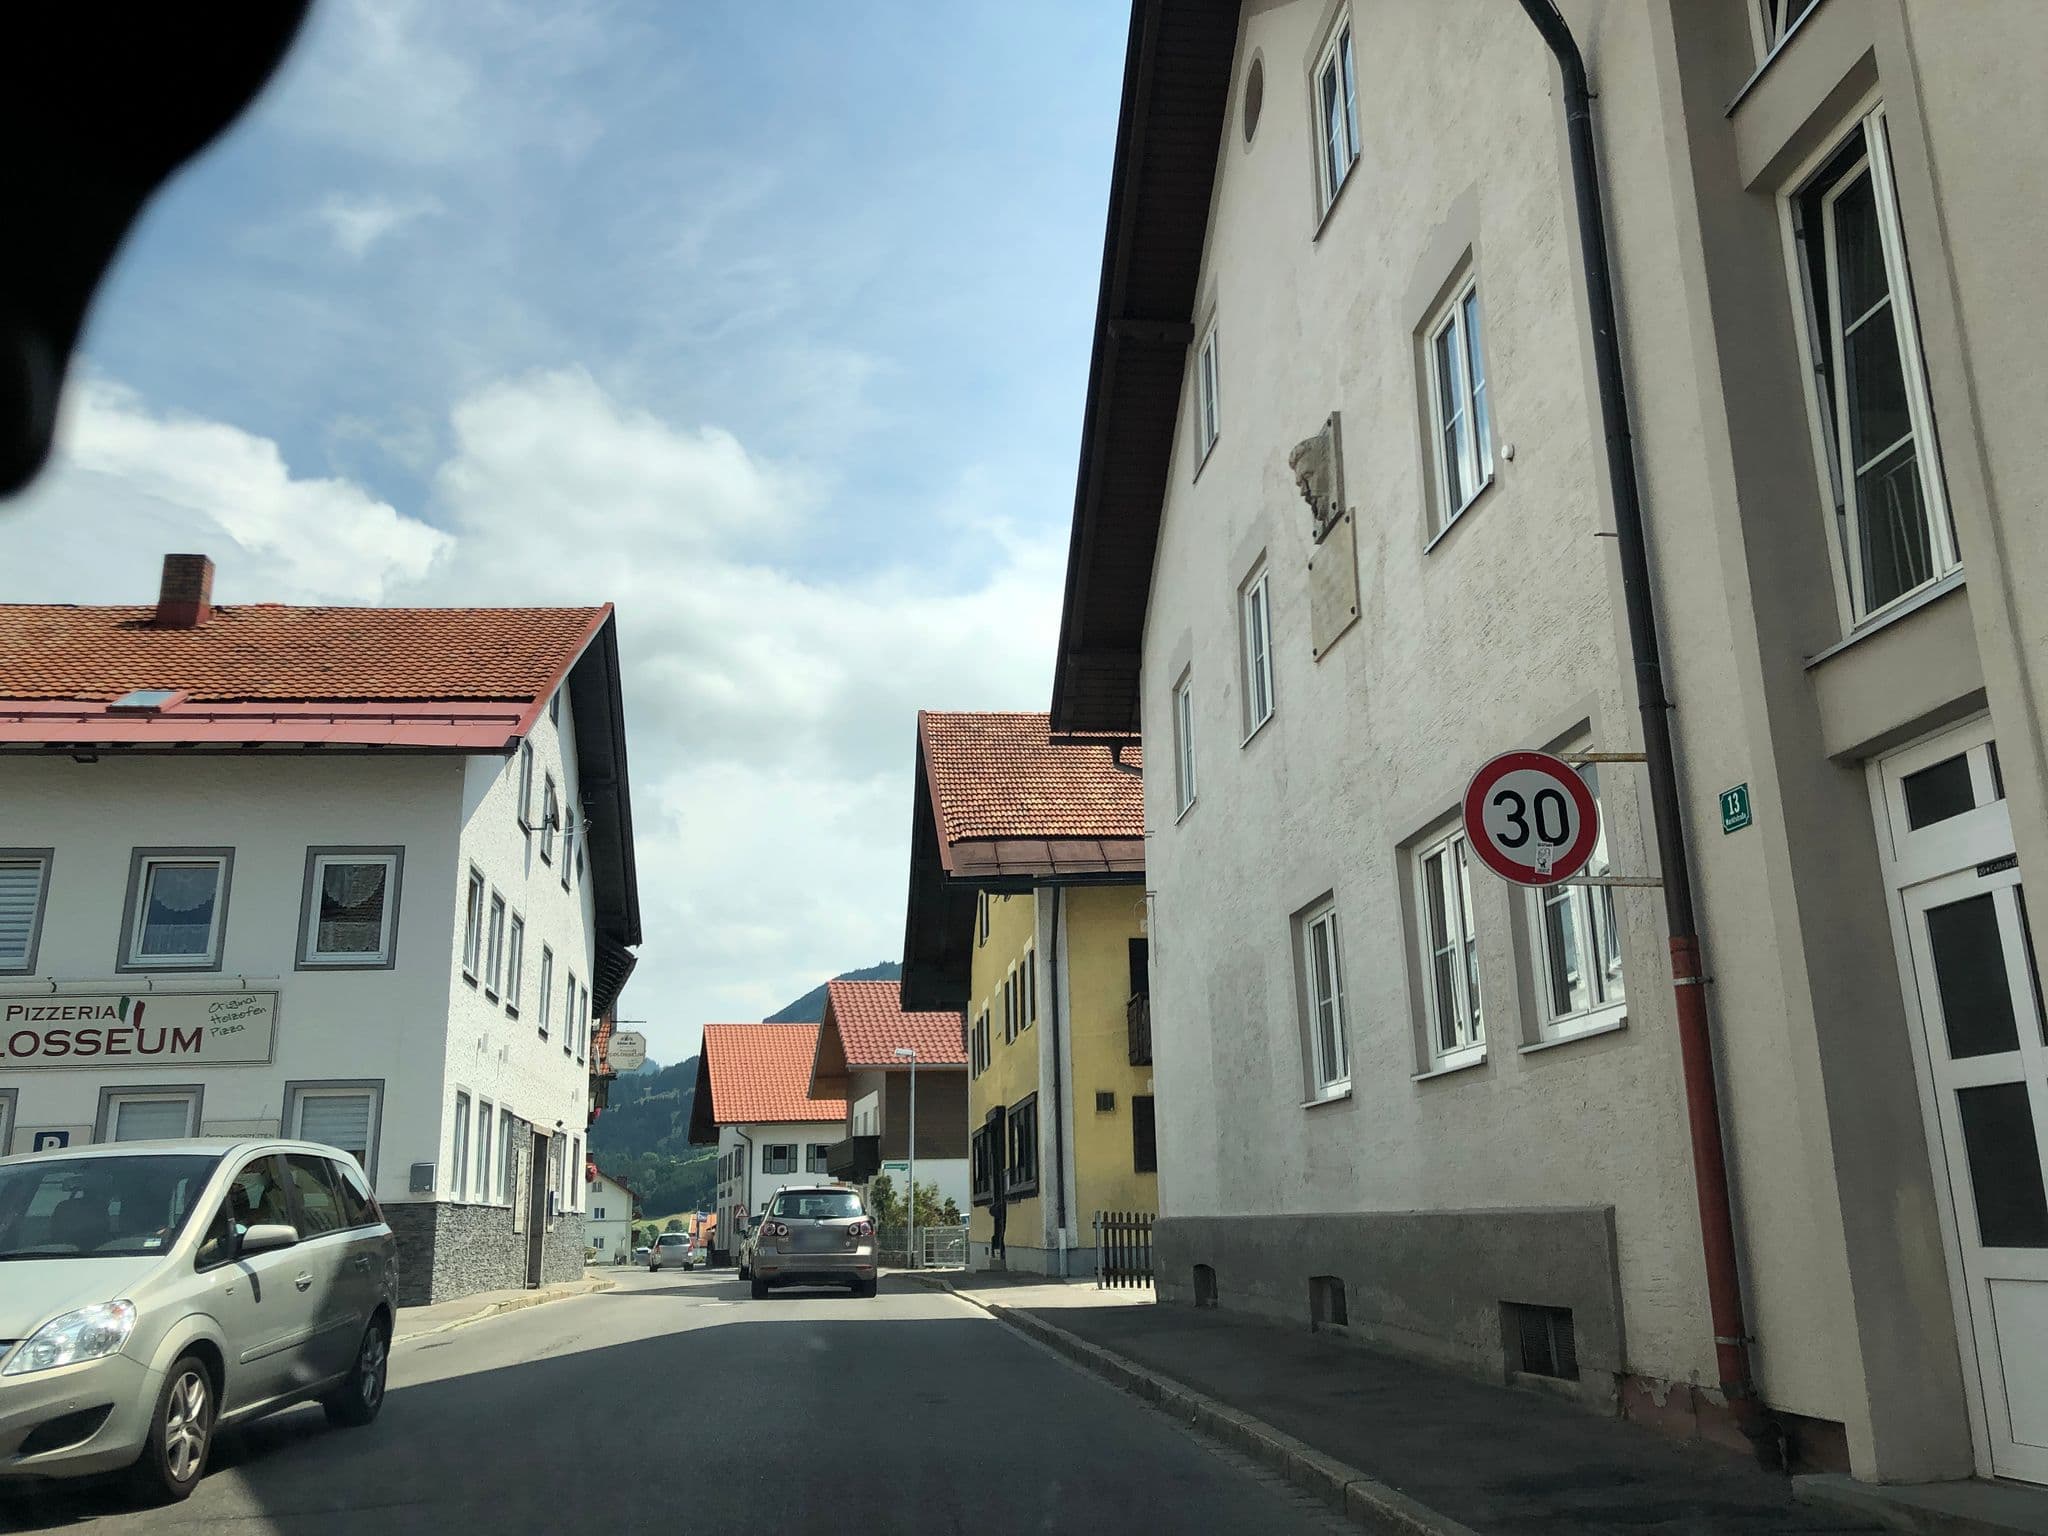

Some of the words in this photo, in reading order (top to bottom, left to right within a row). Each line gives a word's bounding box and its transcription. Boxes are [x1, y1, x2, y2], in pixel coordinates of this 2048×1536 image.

[1727, 792, 1740, 815] 13
[1493, 788, 1570, 848] 30
[208, 995, 257, 1013] Original
[210, 1006, 267, 1024] Holzofen
[210, 1024, 246, 1037] Pizza
[41, 1136, 61, 1151] P
